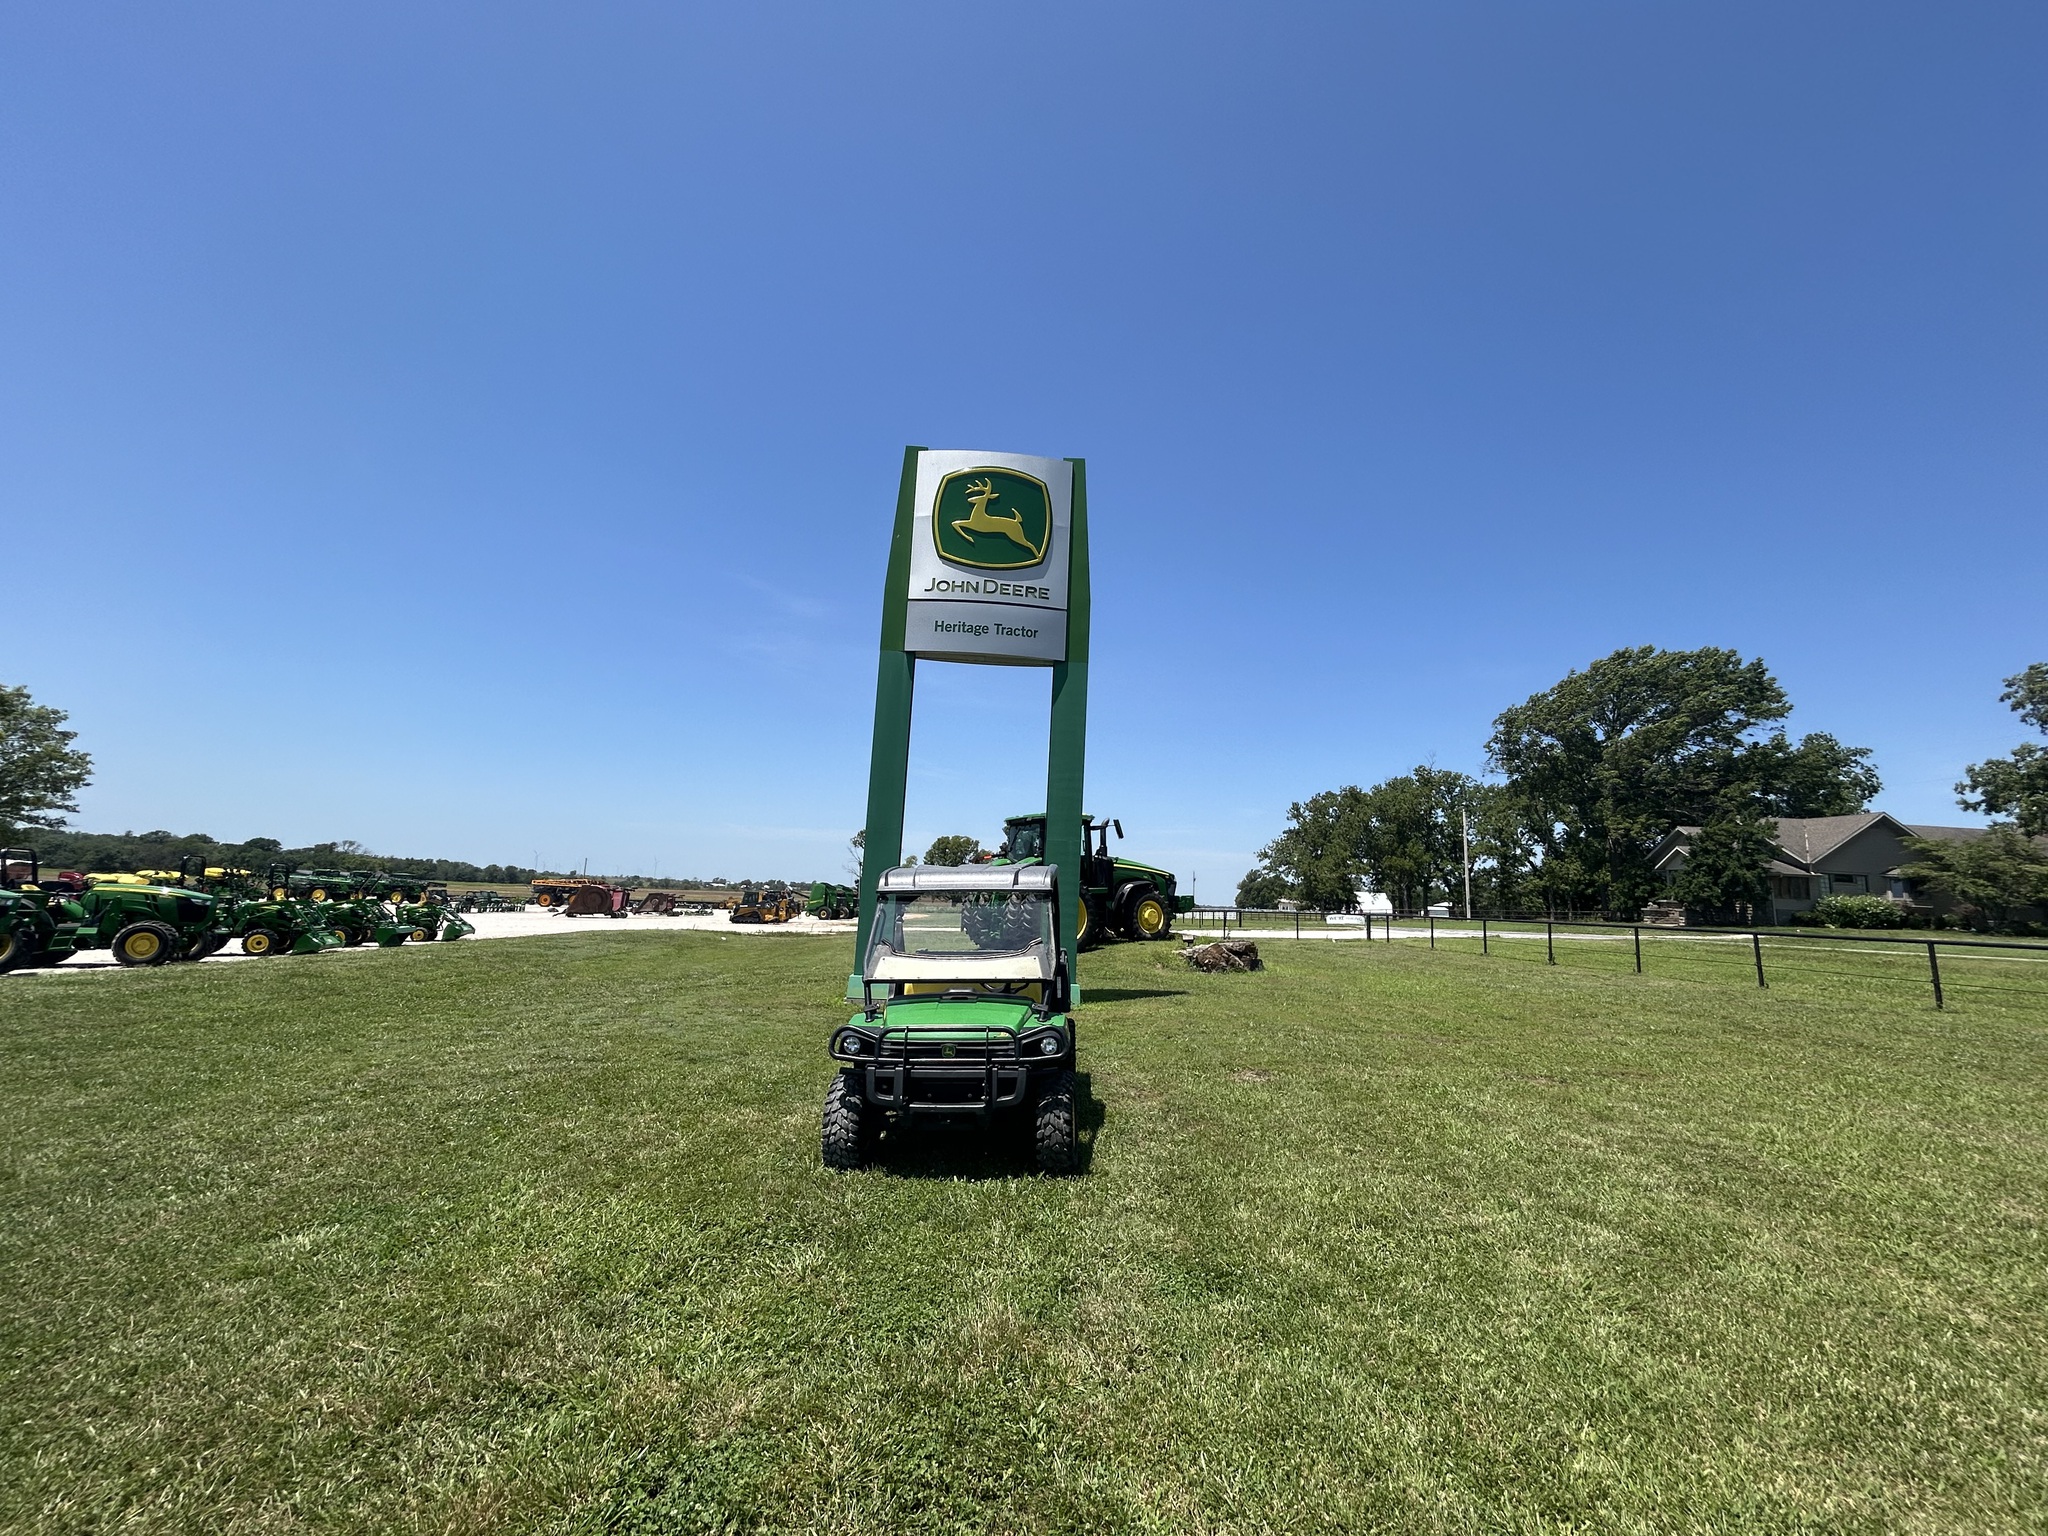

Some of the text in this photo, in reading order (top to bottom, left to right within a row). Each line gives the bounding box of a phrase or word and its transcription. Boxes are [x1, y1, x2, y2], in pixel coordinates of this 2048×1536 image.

[924, 577, 1050, 600] JOHN DEERE
[934, 620, 1039, 638] Heritage Tractor
